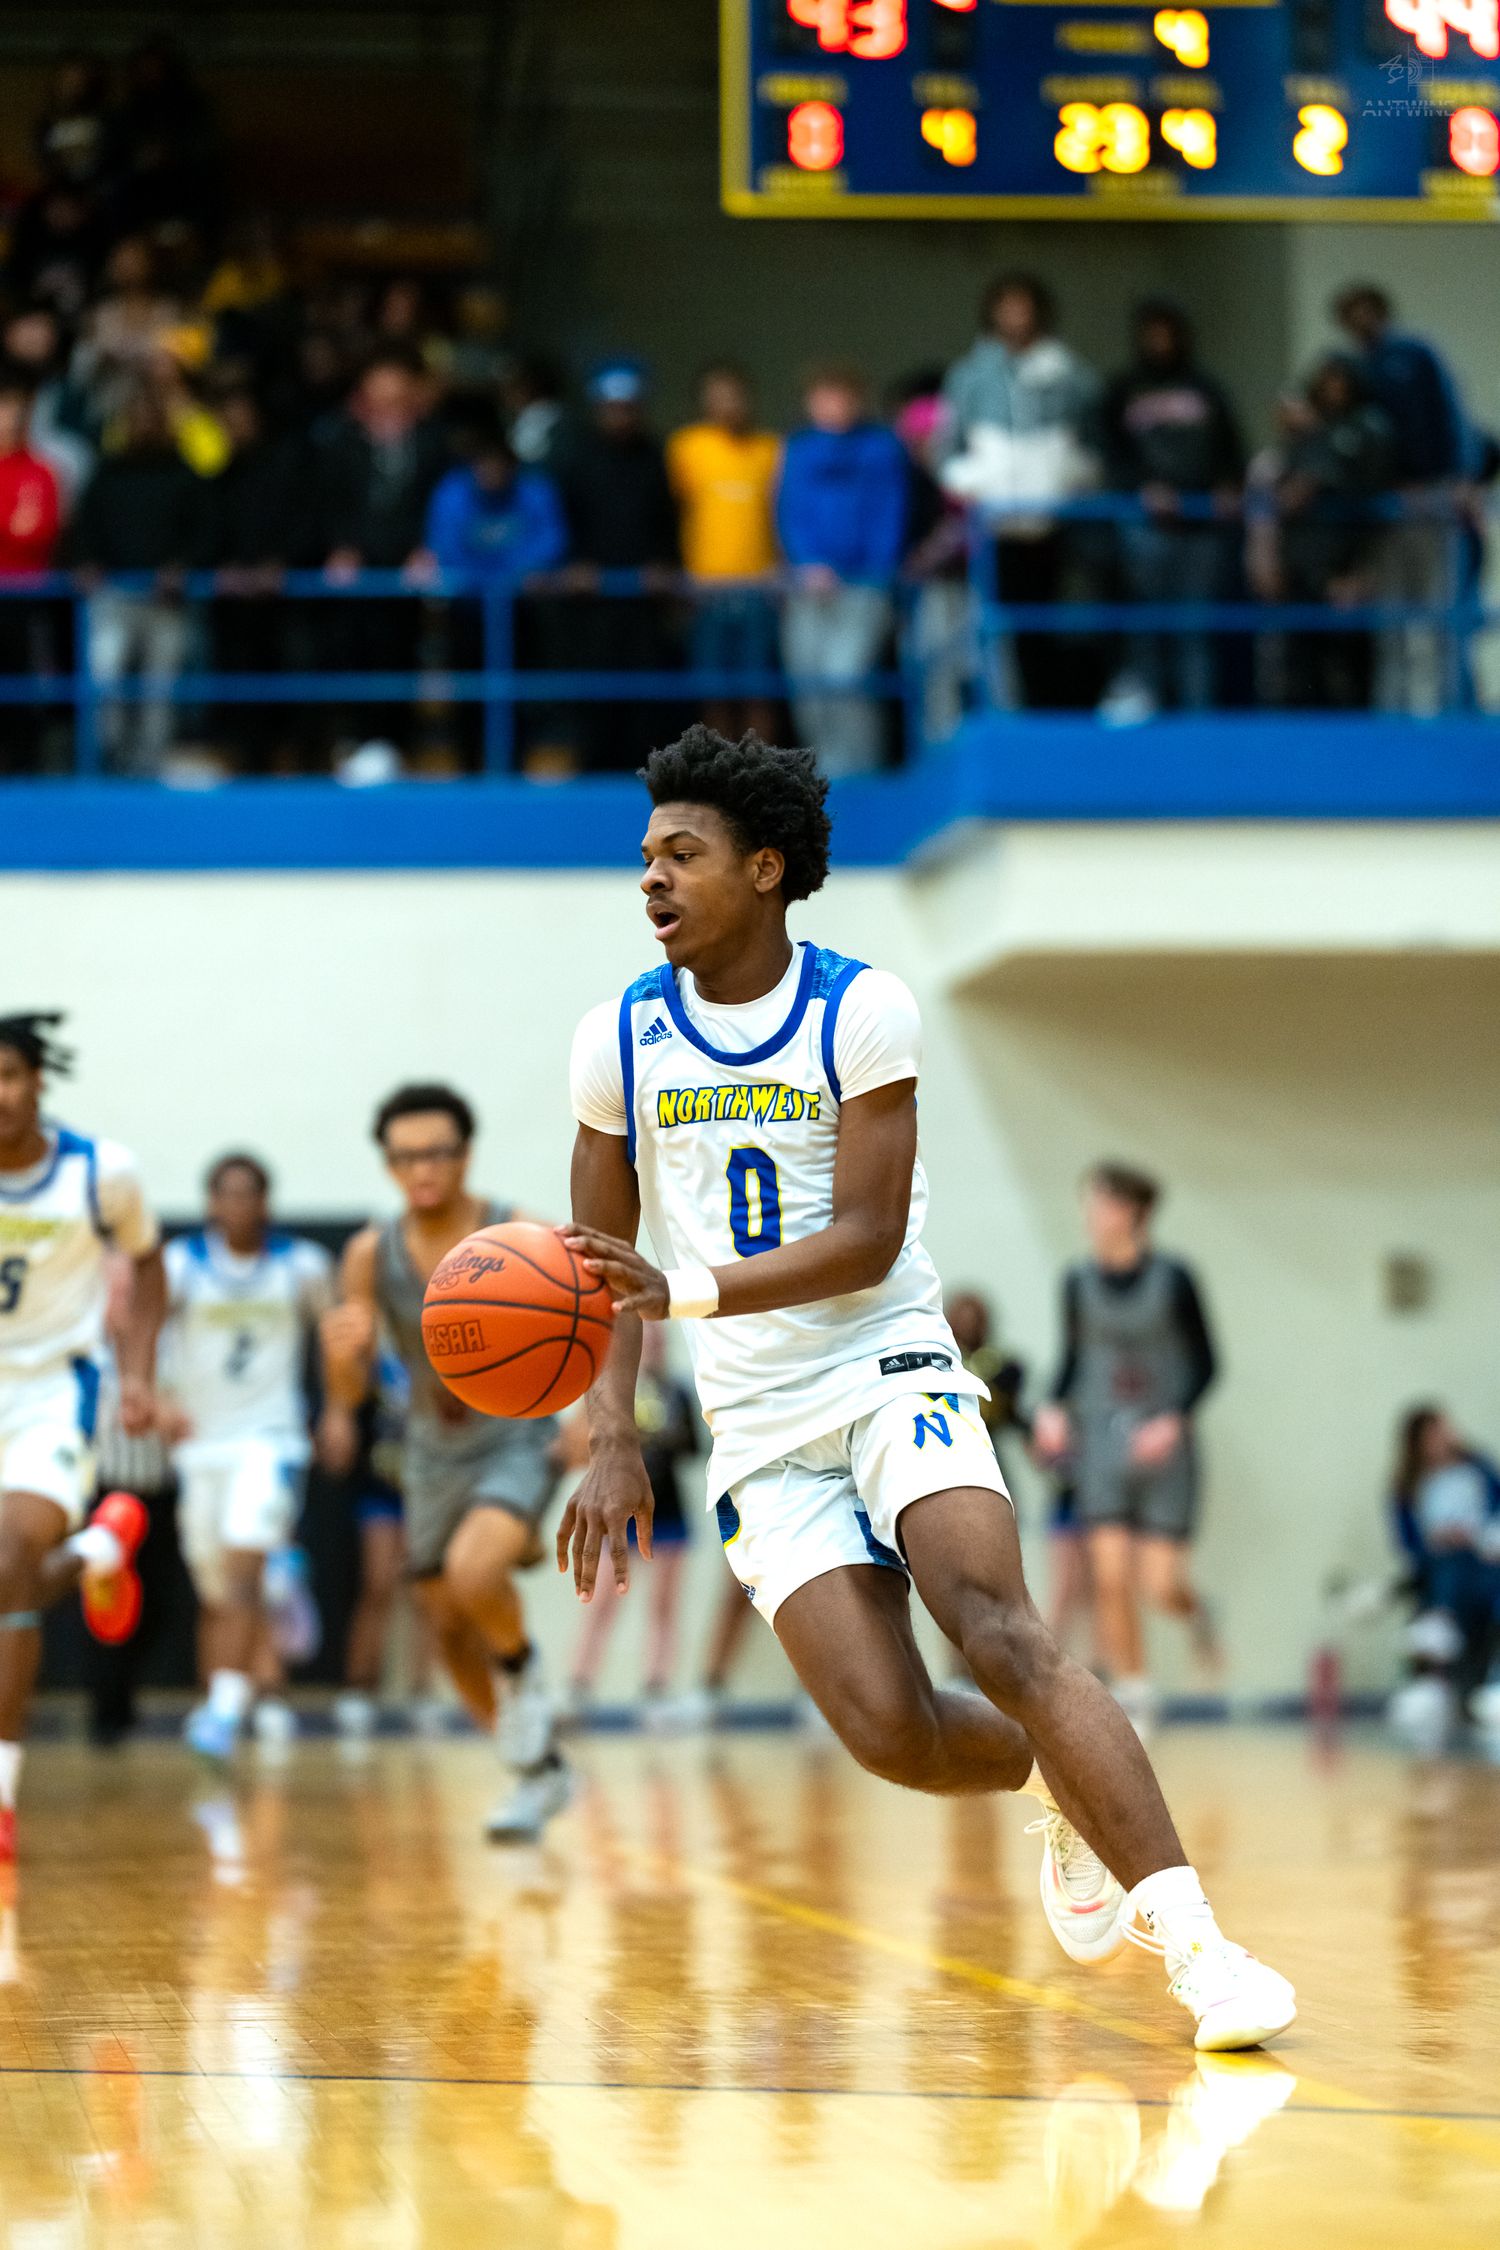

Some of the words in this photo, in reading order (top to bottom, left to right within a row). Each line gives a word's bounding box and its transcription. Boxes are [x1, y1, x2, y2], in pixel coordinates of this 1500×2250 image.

[1293, 104, 1348, 176] 2
[640, 1030, 672, 1046] adidas
[657, 1084, 820, 1128] NORTHWEST
[725, 1145, 784, 1260] 0
[423, 1319, 484, 1356] HSAA
[912, 1410, 954, 1450] N
